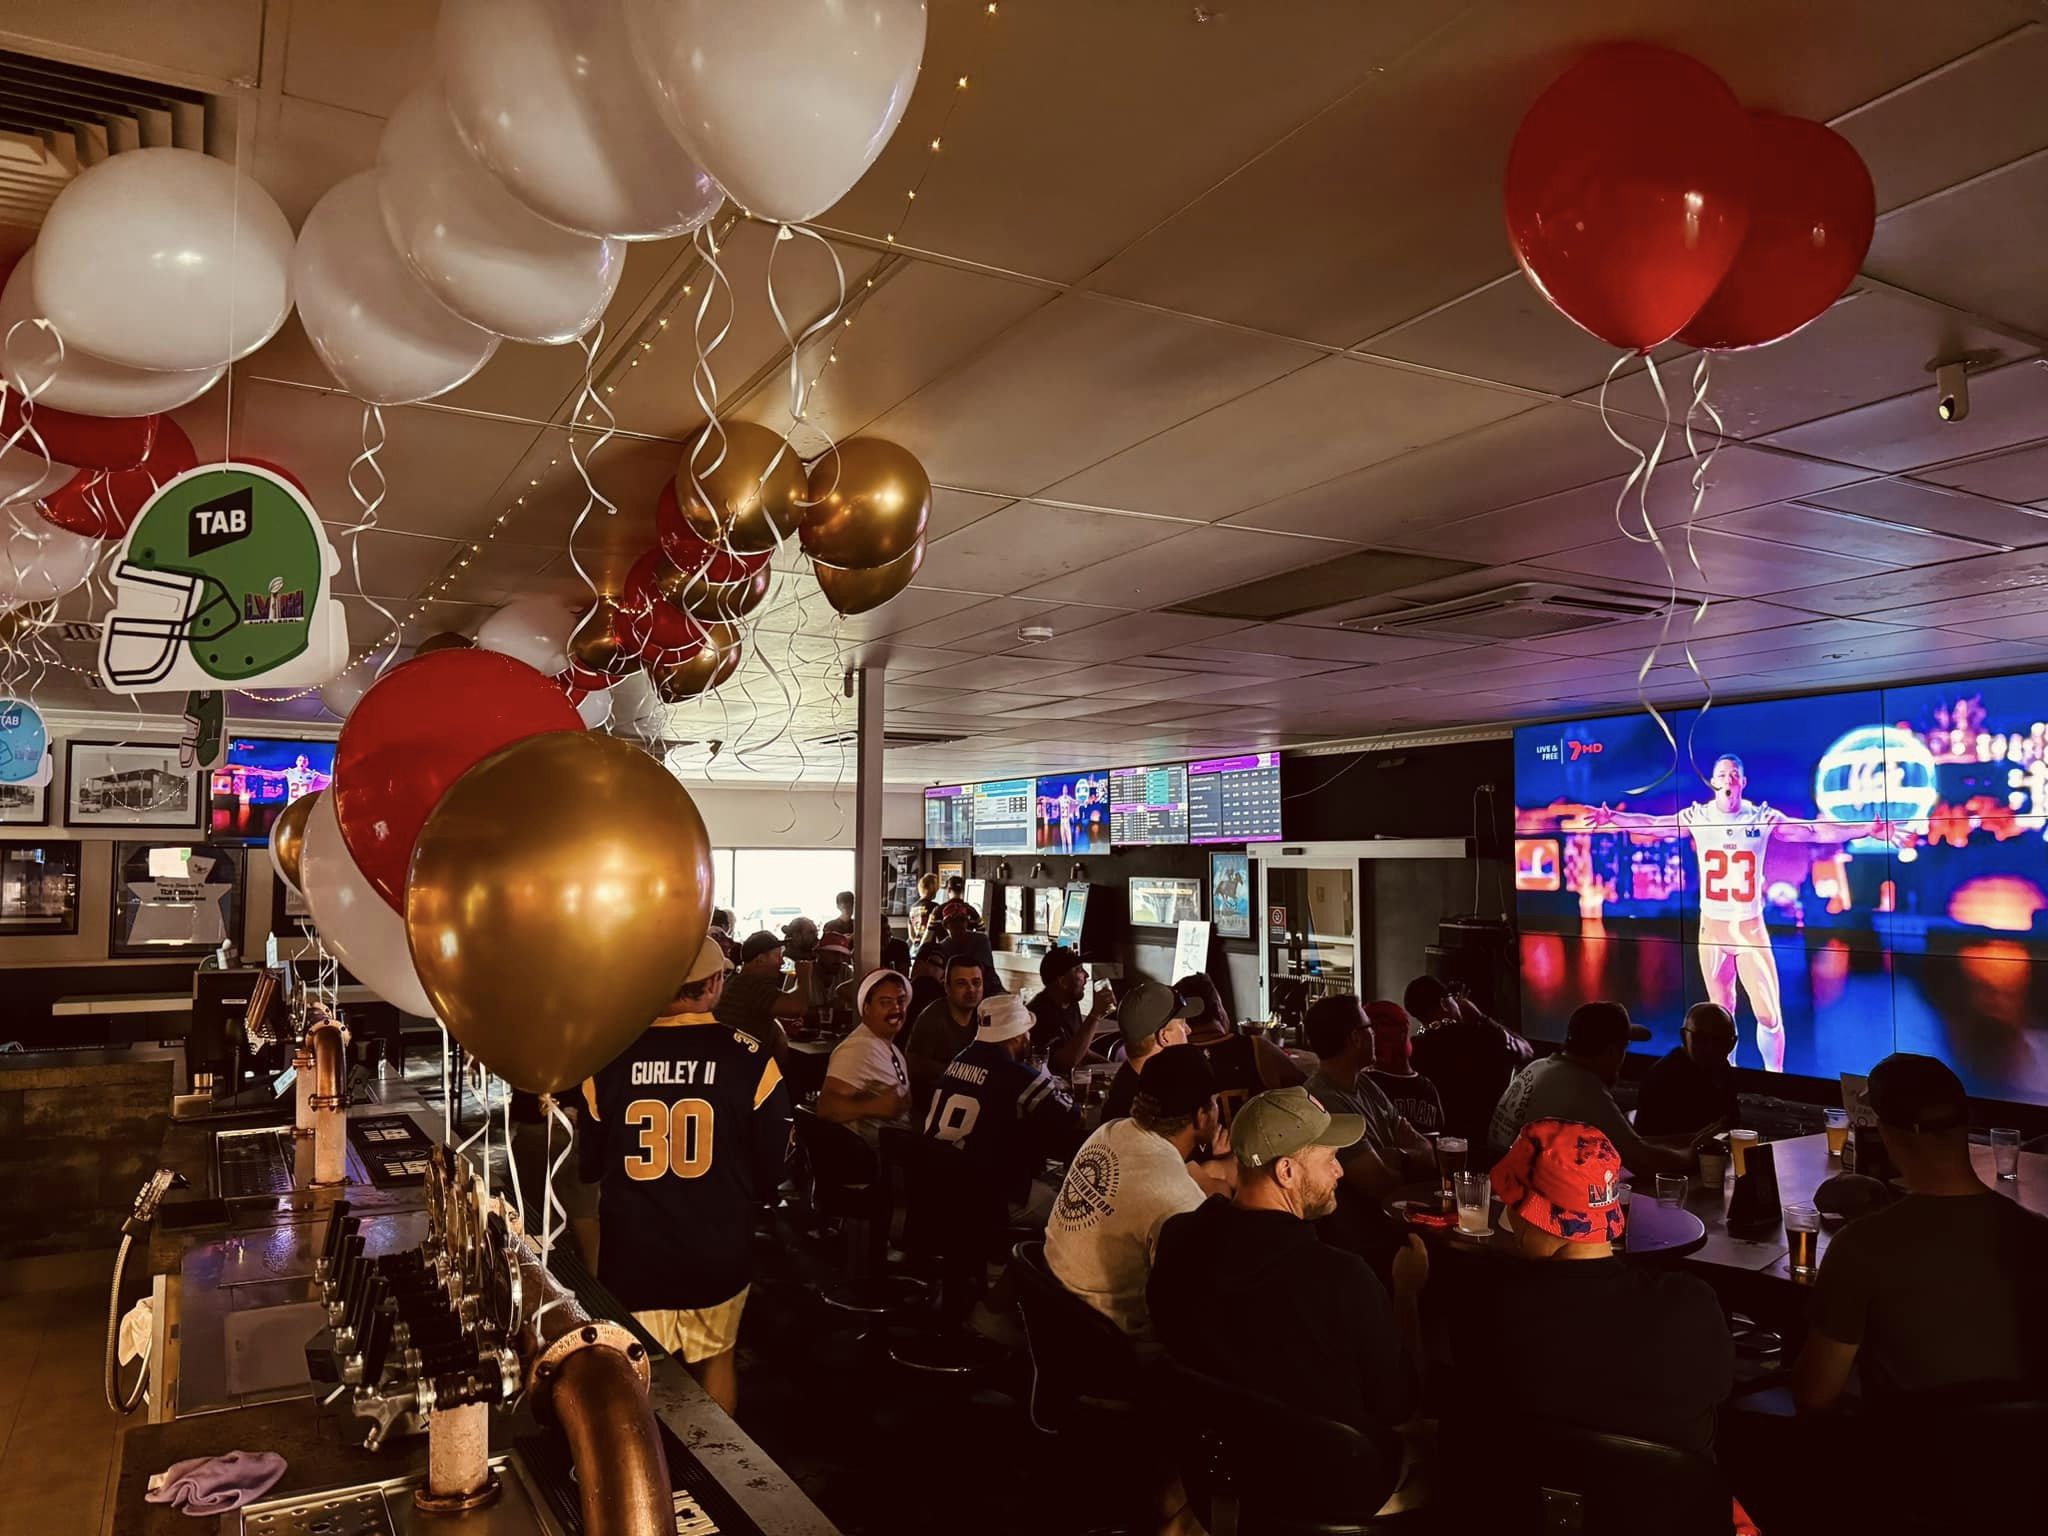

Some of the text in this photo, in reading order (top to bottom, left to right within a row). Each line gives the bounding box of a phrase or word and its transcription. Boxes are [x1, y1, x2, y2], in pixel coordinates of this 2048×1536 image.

[195, 509, 247, 535] TAB
[1536, 745, 1550, 753] LIVE
[1705, 850, 1756, 903] 23
[631, 1061, 716, 1085] GURLEY II
[624, 1098, 714, 1181] 30
